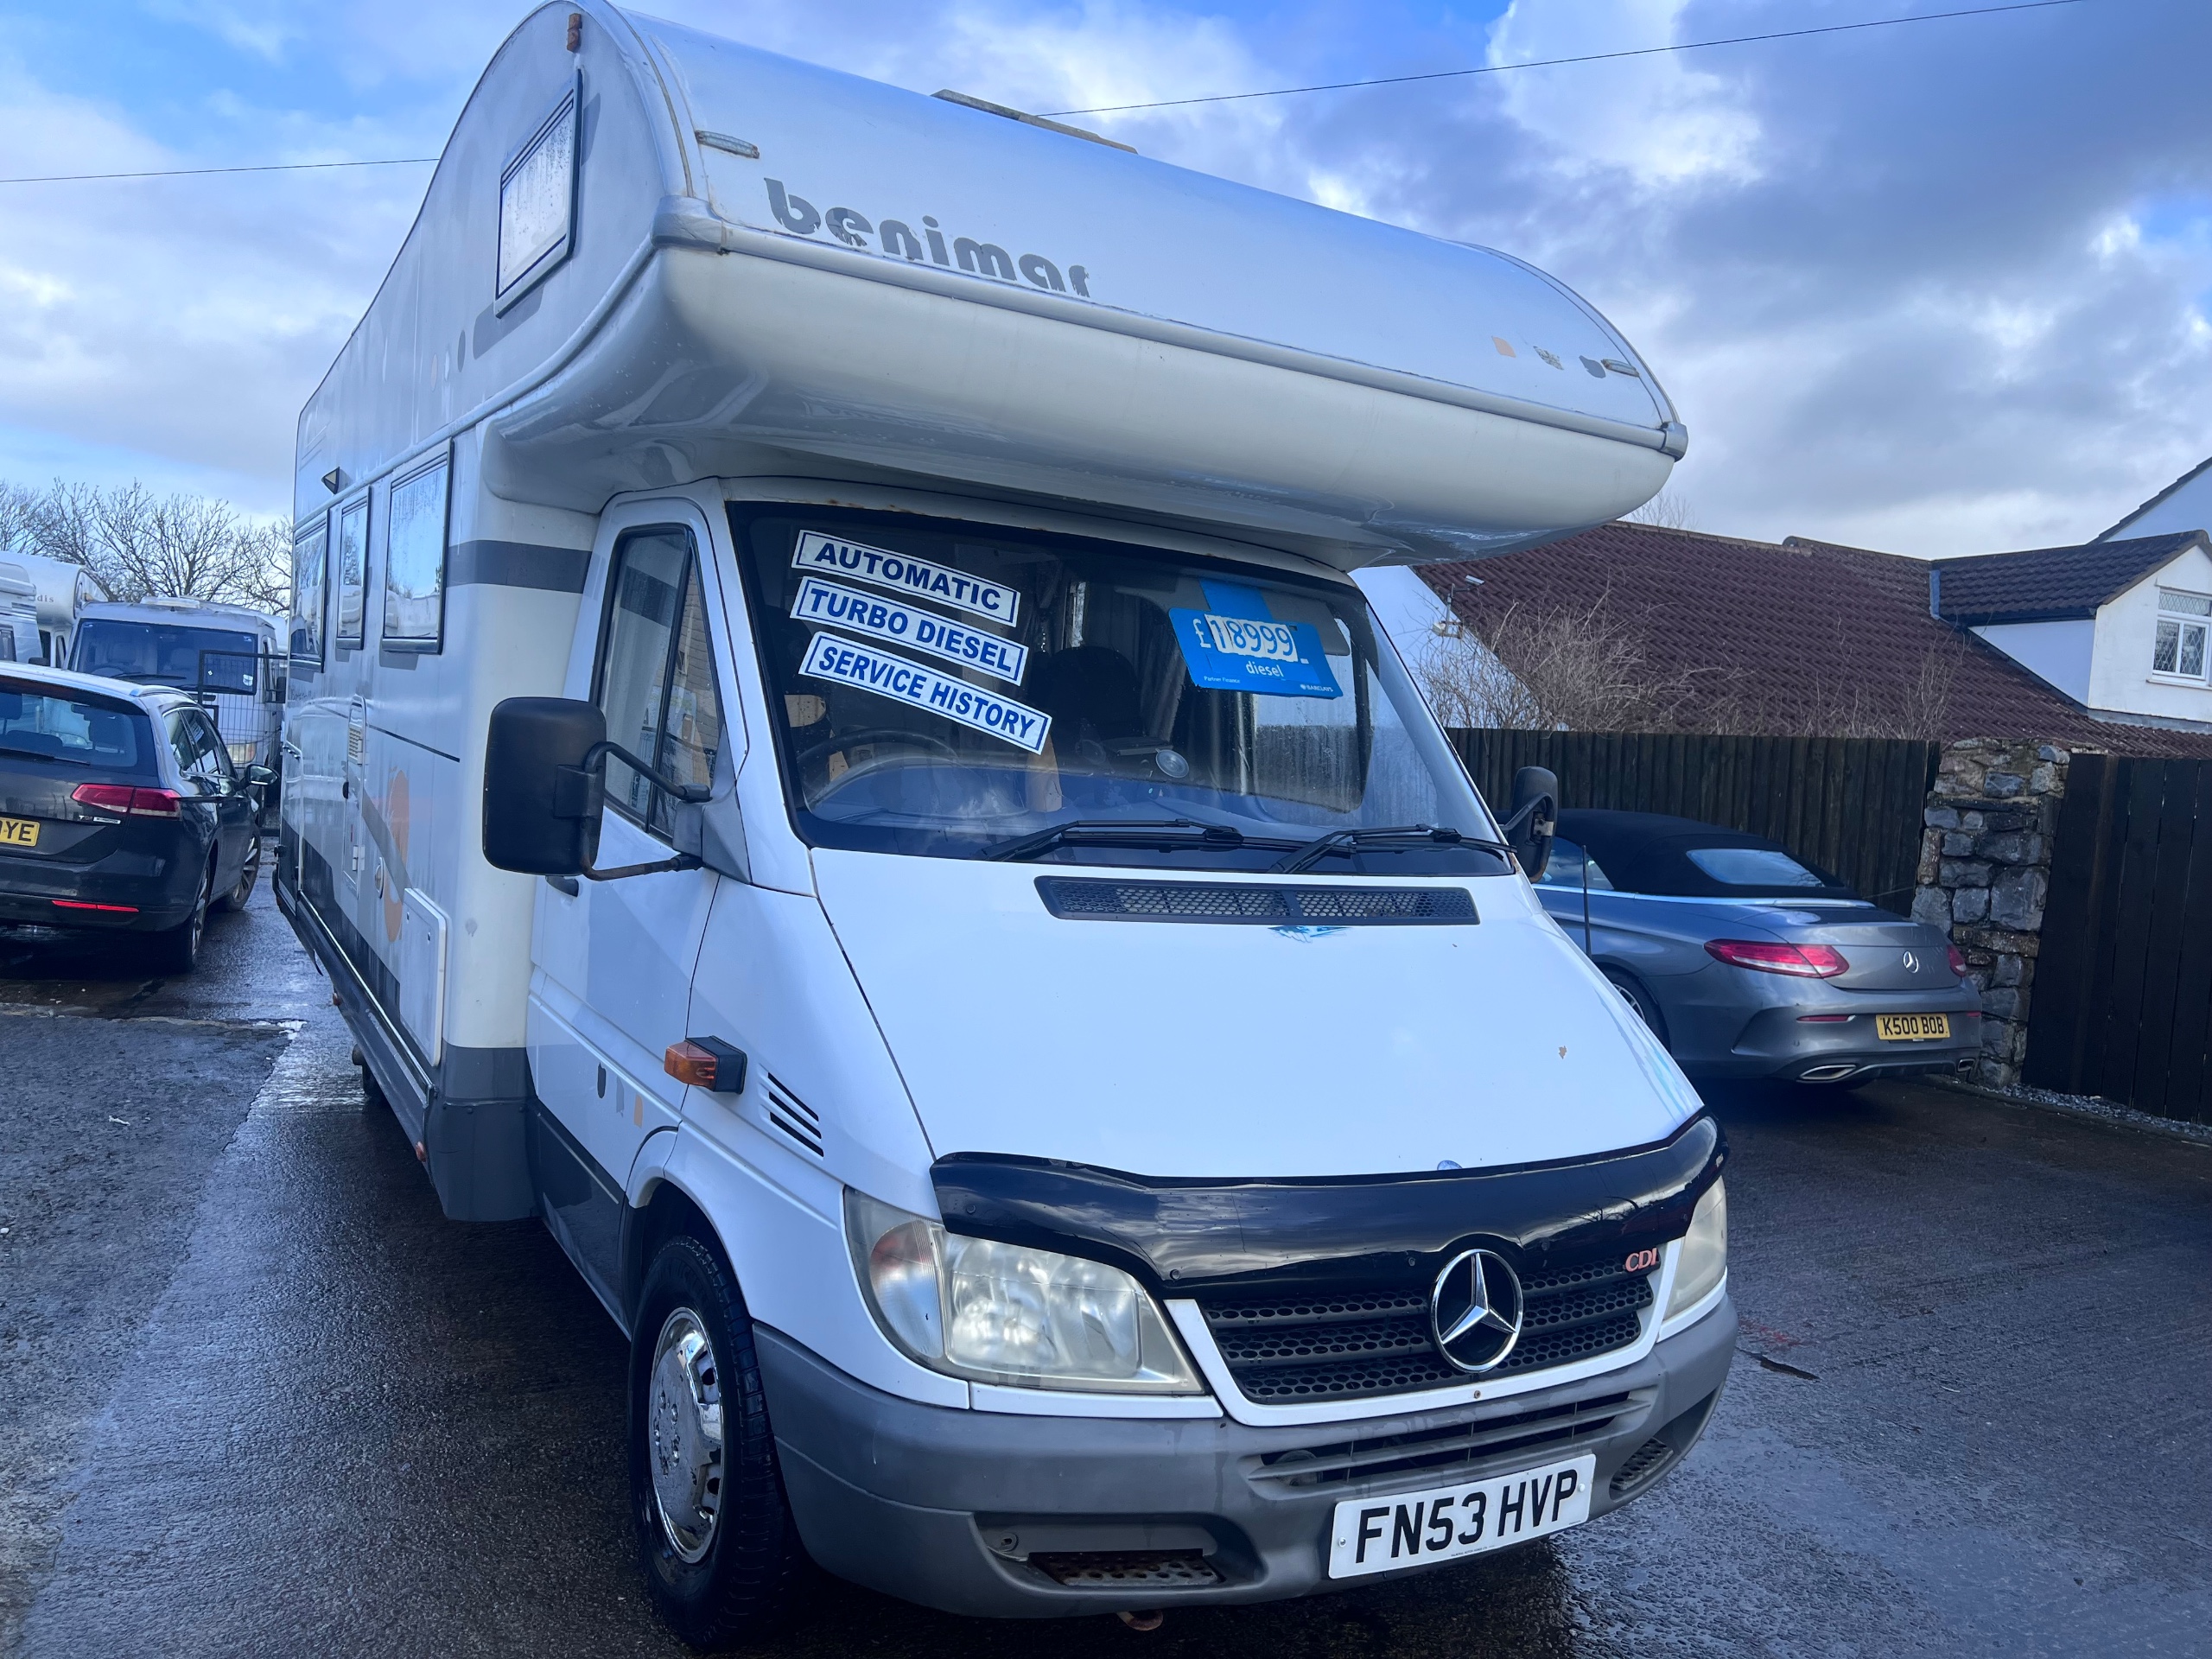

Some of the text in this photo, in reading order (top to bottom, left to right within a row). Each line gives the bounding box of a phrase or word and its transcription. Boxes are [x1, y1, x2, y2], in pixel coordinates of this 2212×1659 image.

[764, 177, 1090, 298] benimar
[815, 542, 1001, 611] AUTOMATIC
[36, 594, 54, 603] dis
[810, 588, 1012, 672] TURBO DIESEL
[1192, 618, 1294, 657] £18999
[1245, 661, 1285, 678] diesel
[819, 646, 1036, 739] SERVICE HISTORY
[0, 820, 35, 842] YE
[1883, 1015, 1944, 1036] K500 BOB
[1625, 1247, 1657, 1273] CDI
[1355, 1468, 1579, 1564] FN53 HVP
